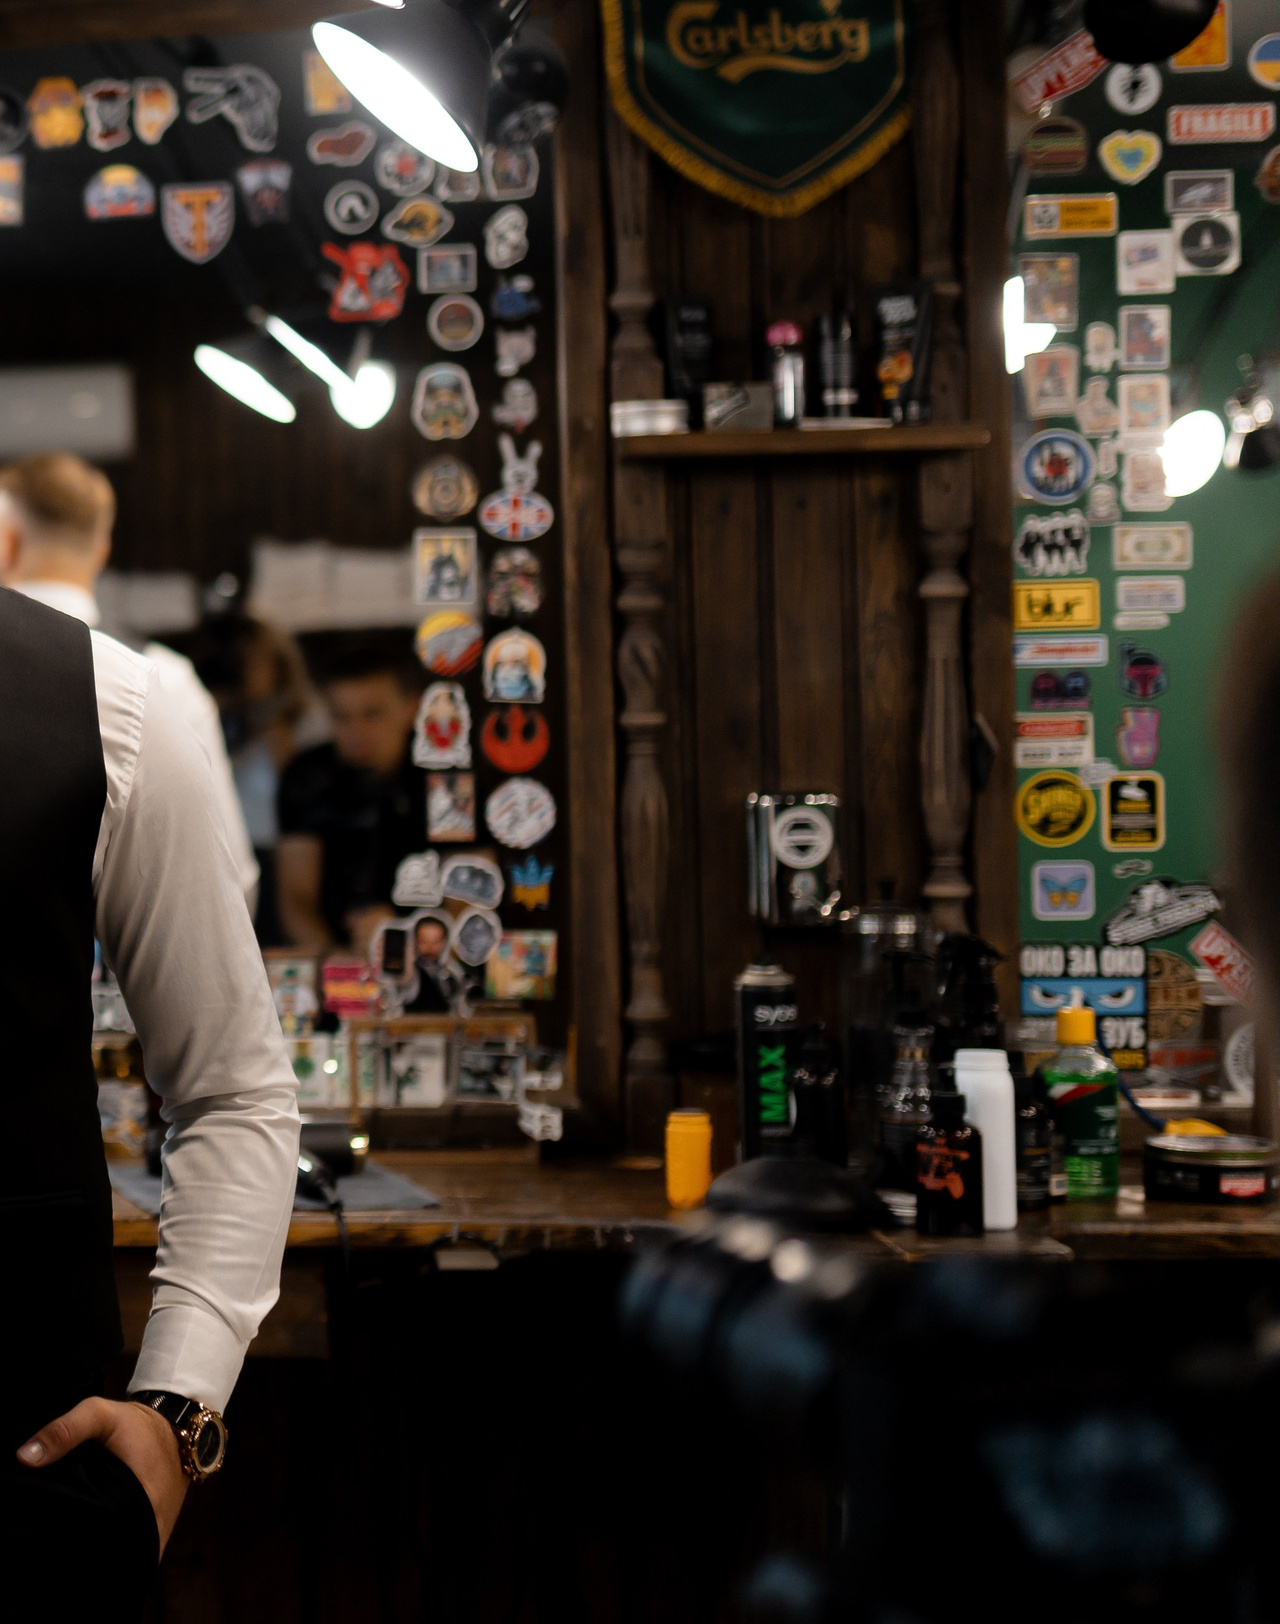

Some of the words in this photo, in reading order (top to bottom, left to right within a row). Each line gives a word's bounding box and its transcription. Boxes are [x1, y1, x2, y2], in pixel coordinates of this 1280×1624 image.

[666, 1, 870, 83] Carlsberg
[1181, 111, 1261, 133] FRAGILE
[1027, 593, 1084, 620] blur
[1021, 945, 1065, 977] ОКО
[1100, 945, 1145, 977] ОКО
[758, 1044, 786, 1124] MAX
